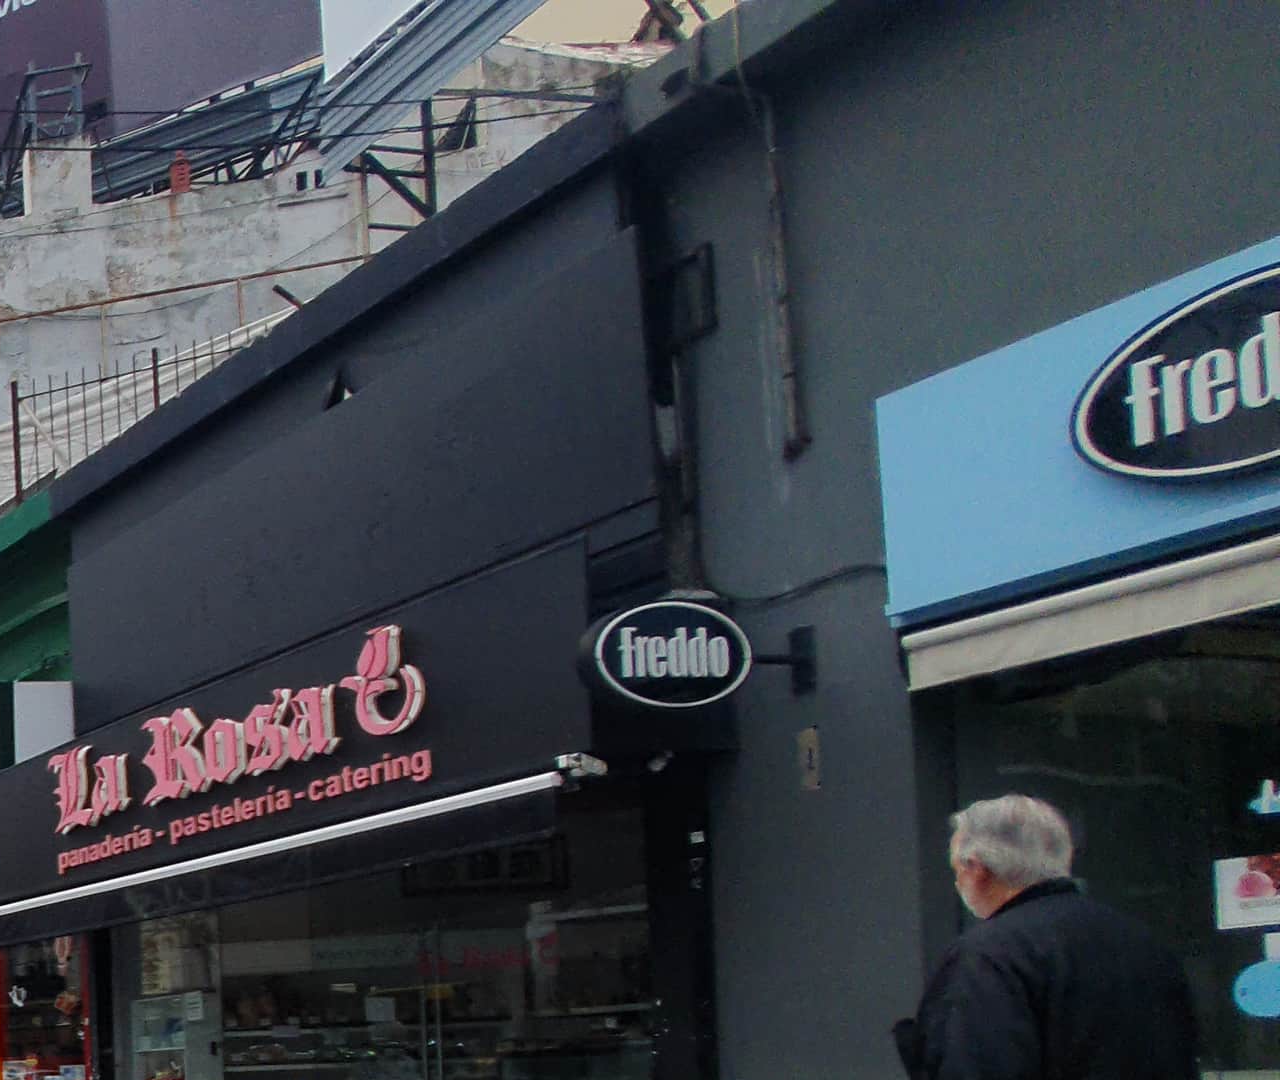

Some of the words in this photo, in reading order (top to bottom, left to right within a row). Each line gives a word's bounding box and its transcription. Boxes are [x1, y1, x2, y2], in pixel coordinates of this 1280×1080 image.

[617, 627, 730, 678] freddo
[47, 744, 133, 835] La
[141, 683, 342, 808] Rosa
[57, 824, 152, 875] panadería
[169, 785, 291, 846] pastelería
[307, 749, 433, 802] catering
